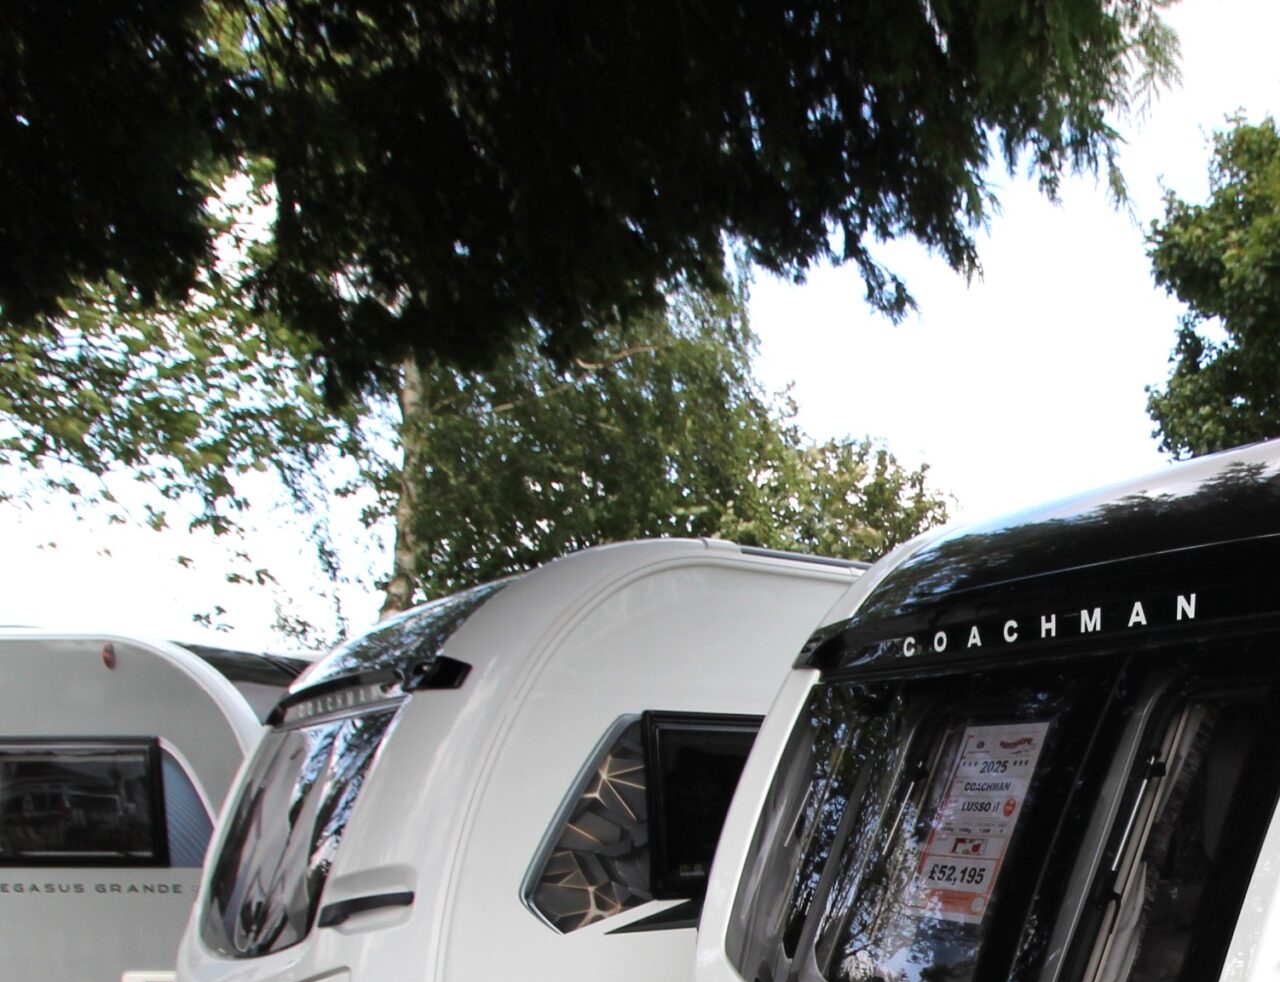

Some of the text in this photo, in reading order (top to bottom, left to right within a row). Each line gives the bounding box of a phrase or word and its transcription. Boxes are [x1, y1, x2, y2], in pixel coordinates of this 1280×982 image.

[902, 593, 1197, 658] COACHMAN
[979, 760, 1009, 775] 2025
[964, 781, 1011, 793] COACHMAN
[961, 801, 991, 813] LUSSO
[928, 864, 986, 886] £52,195
[95, 883, 183, 894] GRANDE
